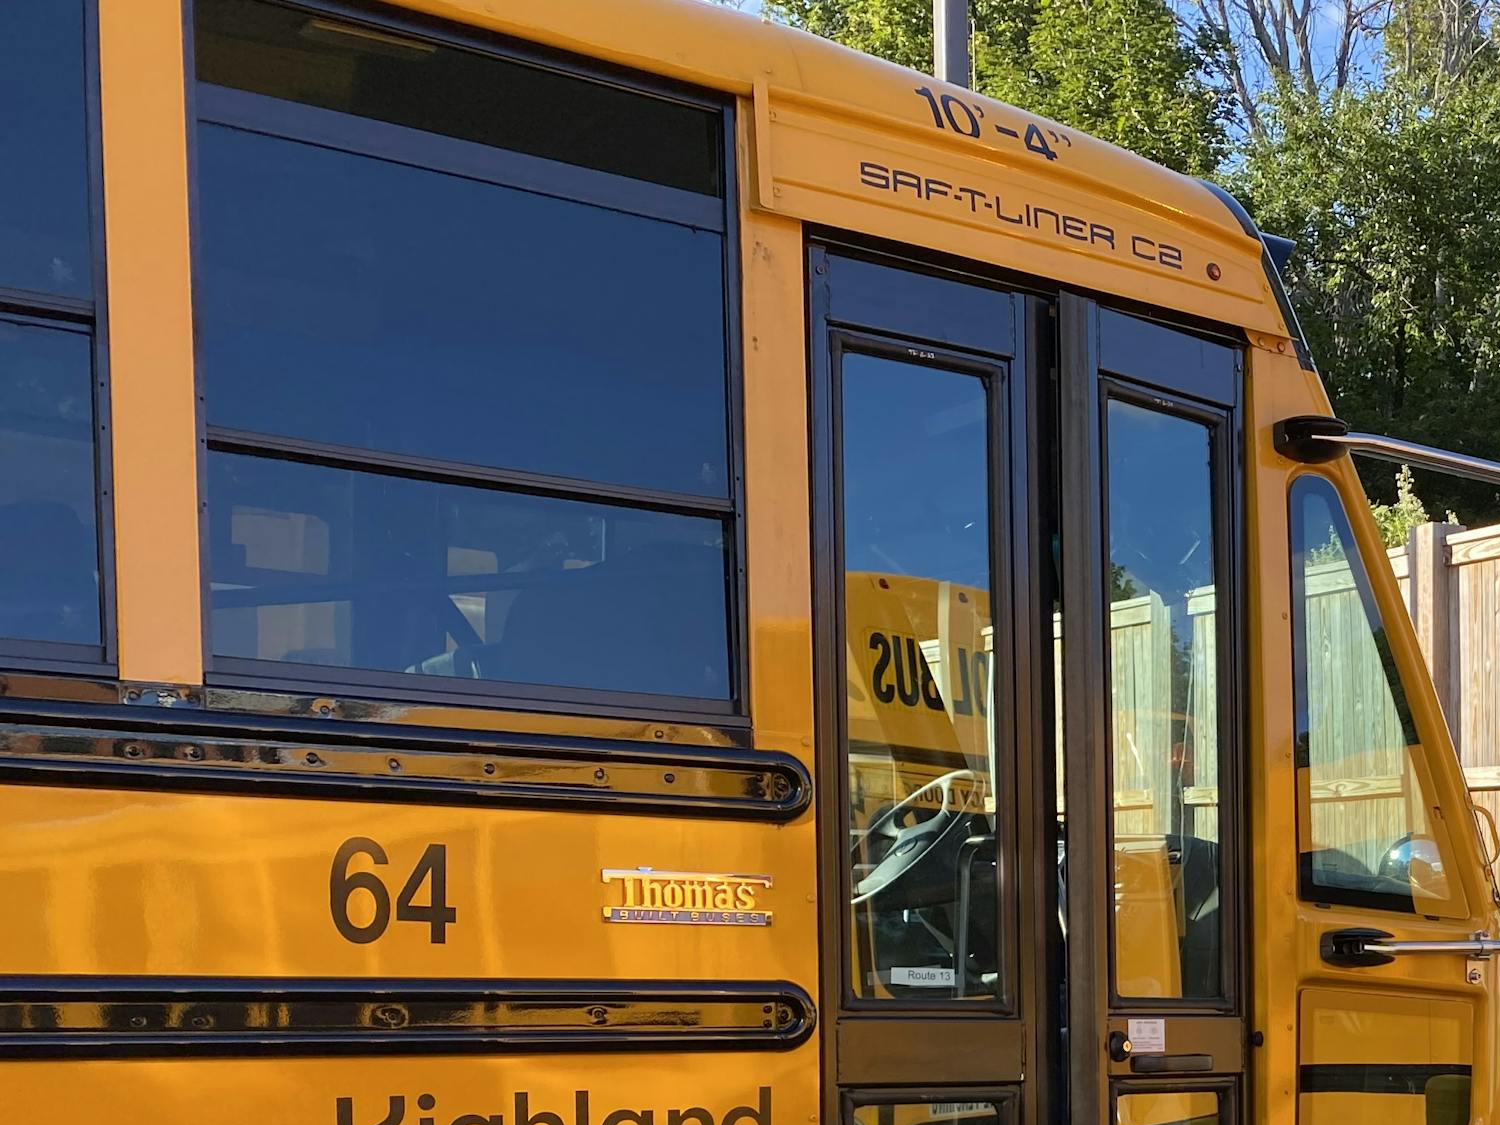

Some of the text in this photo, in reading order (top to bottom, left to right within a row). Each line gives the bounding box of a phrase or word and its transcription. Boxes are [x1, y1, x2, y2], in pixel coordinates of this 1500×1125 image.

[860, 161, 1183, 270] SAF-T-LINER C2
[330, 836, 457, 944] 64
[623, 876, 756, 910] Thomas
[908, 970, 952, 981] Route 13
